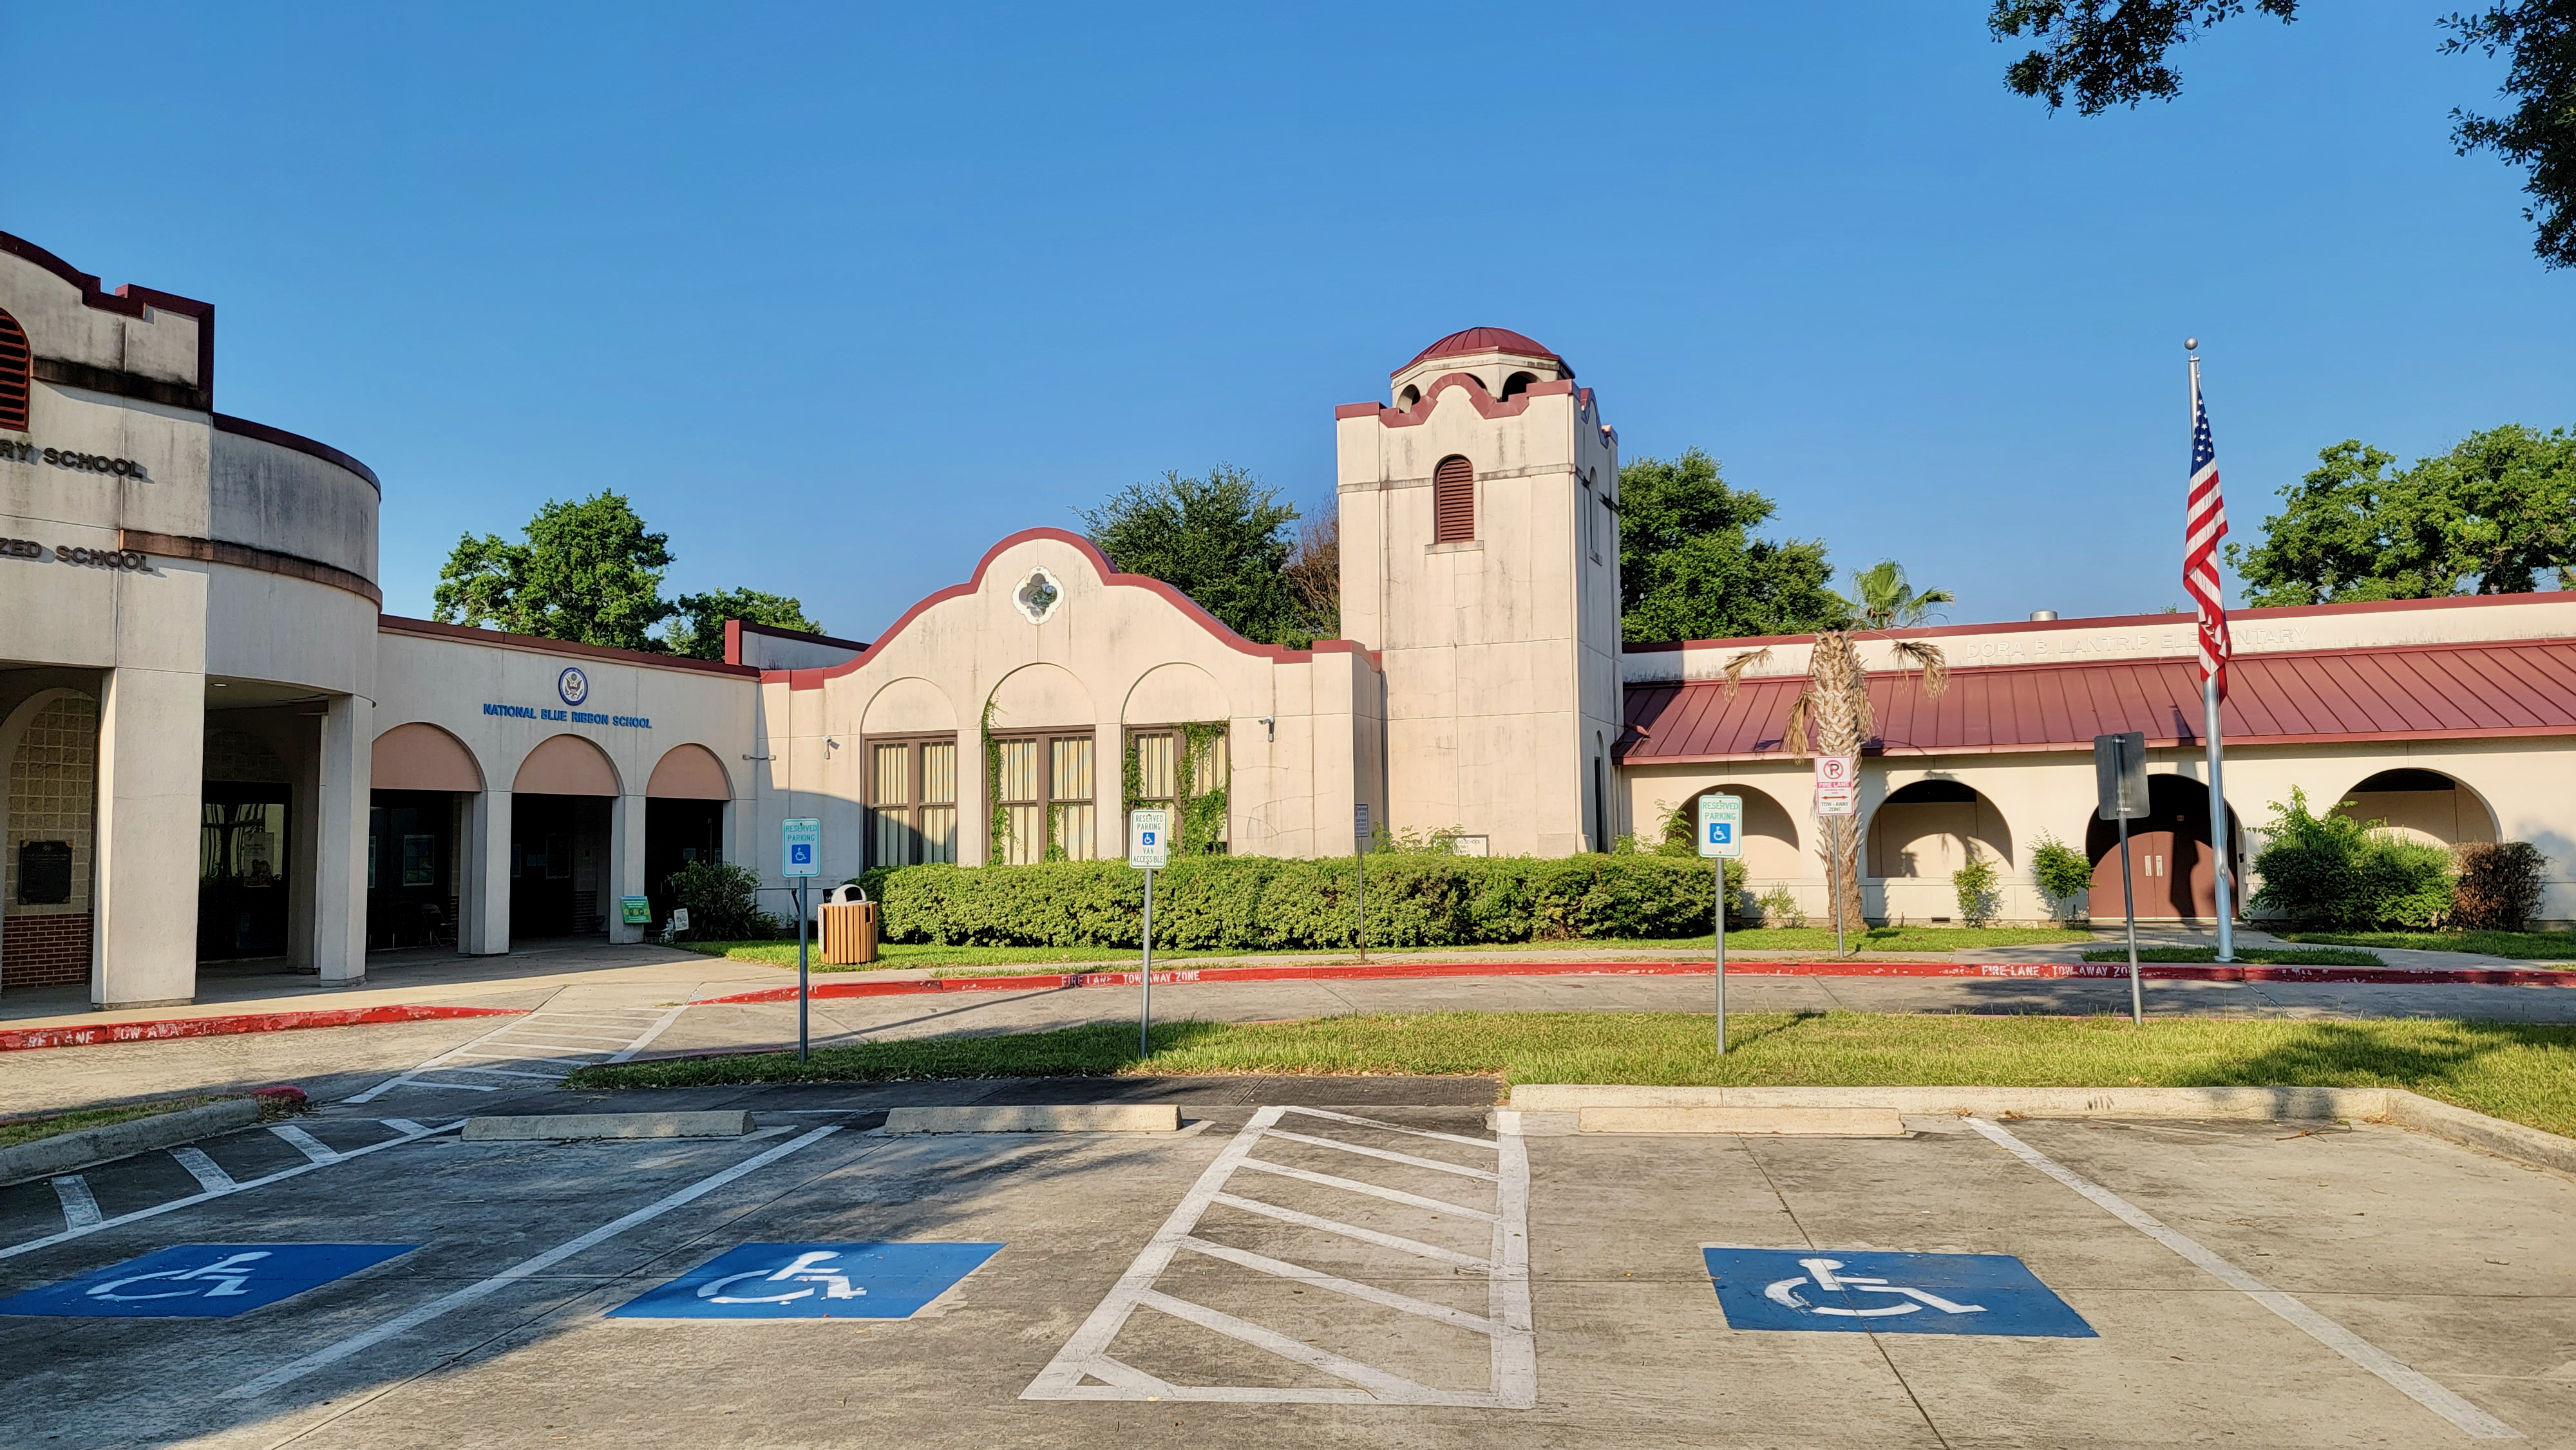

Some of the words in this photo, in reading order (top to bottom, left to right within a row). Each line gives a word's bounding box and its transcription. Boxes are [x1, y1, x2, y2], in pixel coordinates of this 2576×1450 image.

[43, 447, 143, 478] SCHOOL
[55, 545, 153, 571] SCHOOL
[1966, 641, 2025, 658] DORA
[2034, 639, 2053, 655] B.
[2059, 634, 2150, 654] LANTRIP
[2161, 626, 2308, 649] ELENTARY
[484, 703, 537, 719] NATIONAL
[541, 708, 567, 721] BLUE
[571, 711, 609, 725] RIBBON
[612, 715, 652, 729] SCHOOL
[1703, 802, 1739, 810] RESERVED
[1061, 975, 1083, 986] FIRE
[1122, 974, 1142, 984] TOW
[1148, 972, 1171, 983] WAY
[1175, 970, 1200, 982] ZONE
[1982, 965, 2007, 976] FIRE
[2011, 965, 2039, 976] LANE
[2079, 966, 2108, 976] AWAY
